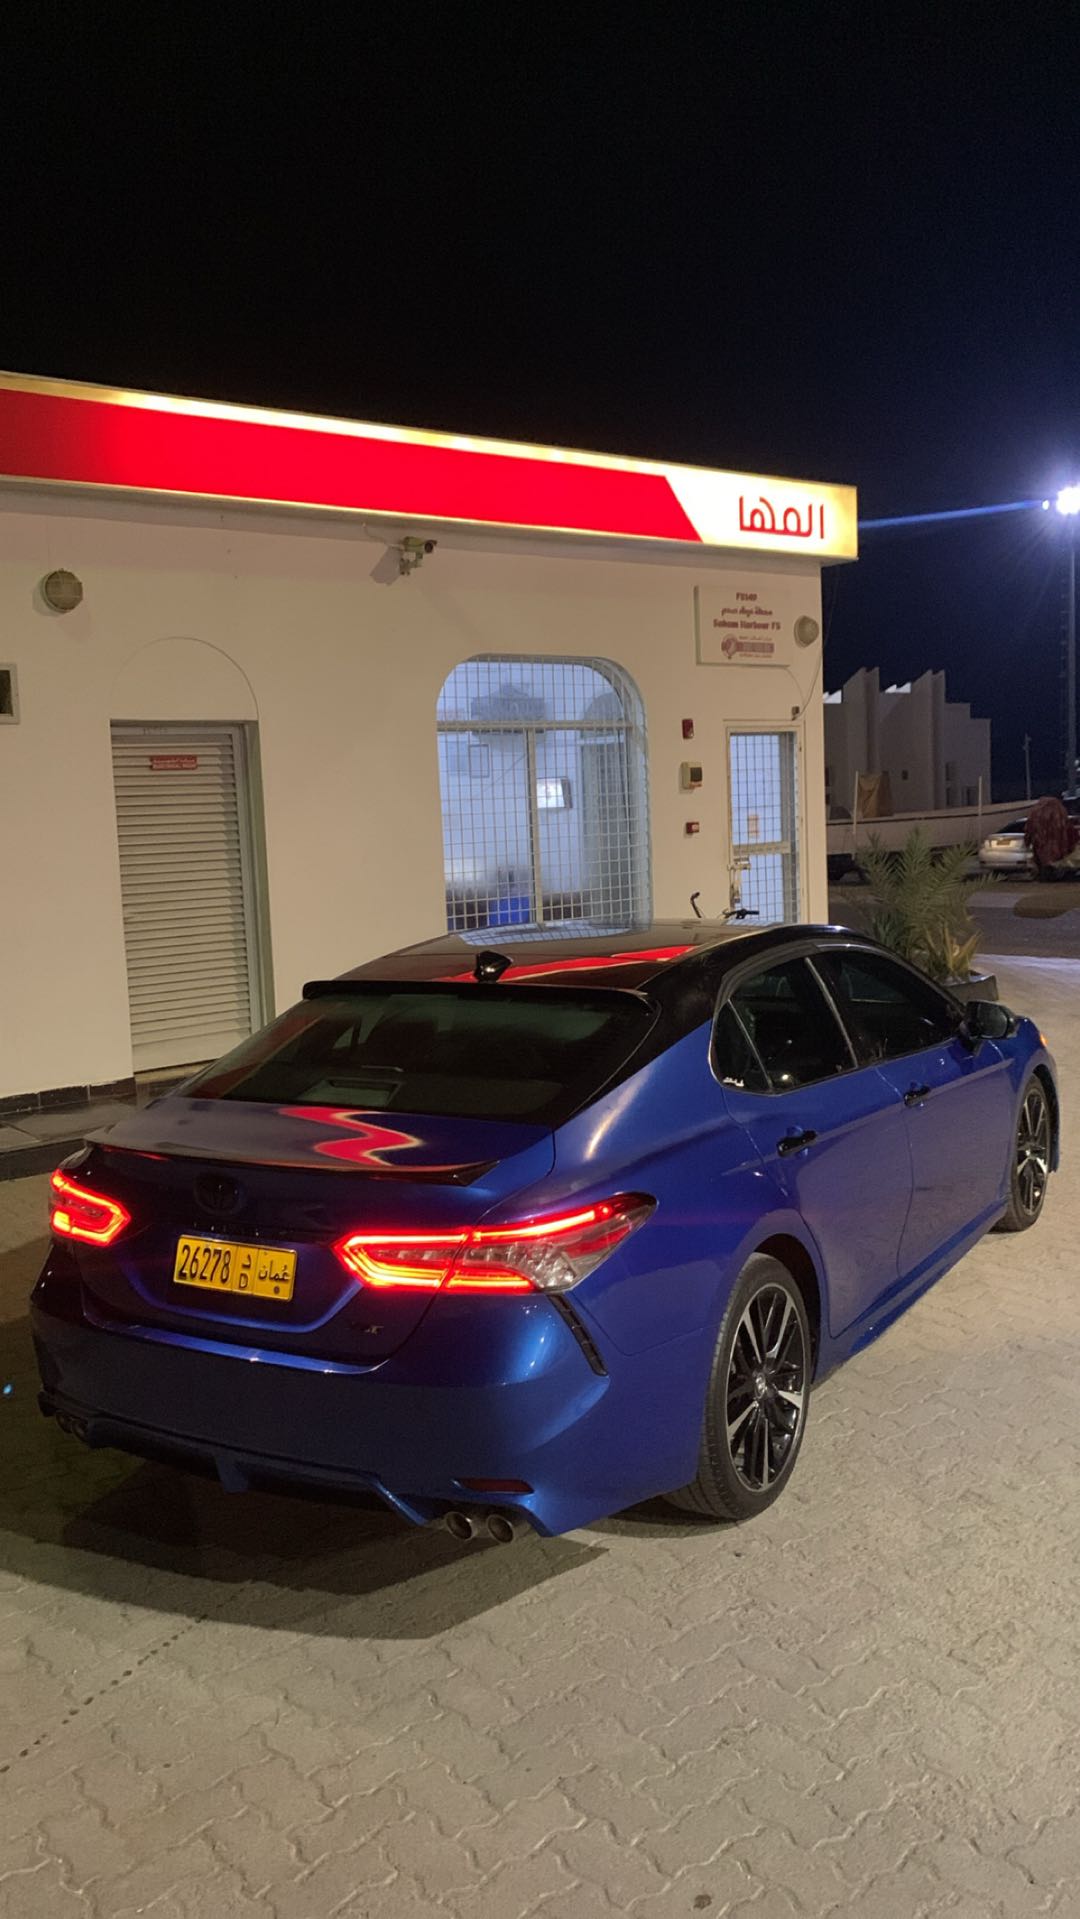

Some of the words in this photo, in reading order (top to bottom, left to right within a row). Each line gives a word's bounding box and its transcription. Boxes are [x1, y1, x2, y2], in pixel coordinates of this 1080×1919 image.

[739, 495, 825, 540] المها
[178, 1244, 232, 1285] 26278
[239, 1272, 249, 1289] D
